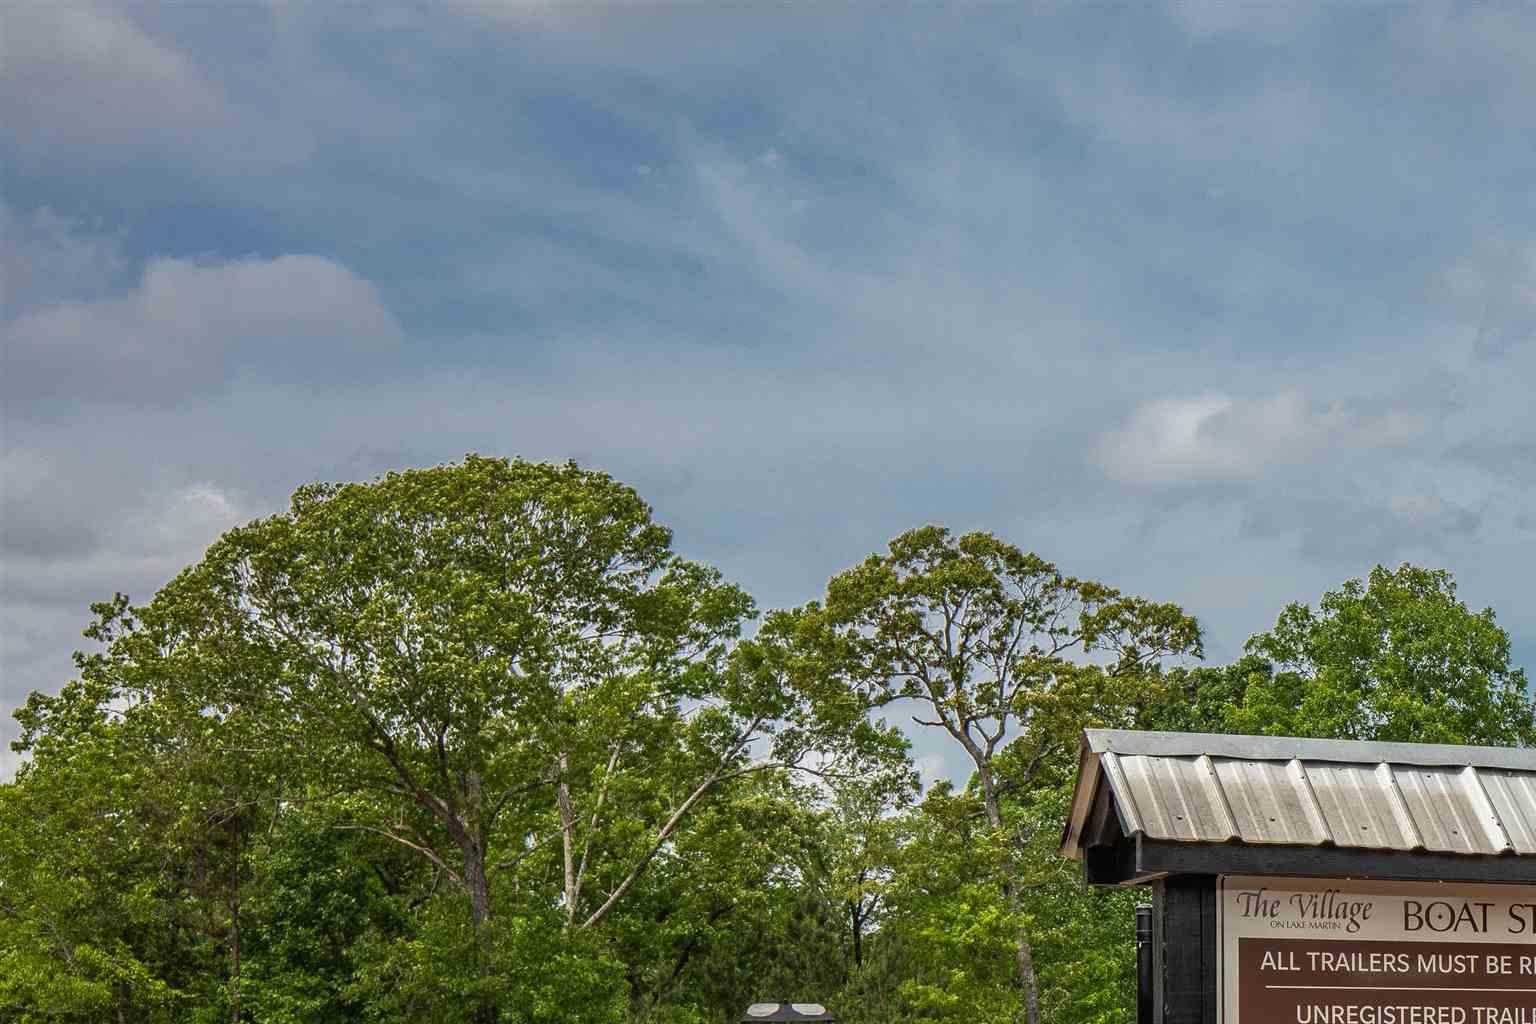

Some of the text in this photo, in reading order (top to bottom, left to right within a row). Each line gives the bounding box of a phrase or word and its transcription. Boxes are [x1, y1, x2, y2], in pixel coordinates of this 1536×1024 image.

[1237, 888, 1372, 933] The Village
[1404, 901, 1494, 933] BOAT
[1270, 920, 1341, 930] ON LAKE MARTIN
[1260, 951, 1300, 971] ALL
[1307, 952, 1410, 973] TRAILERS
[1417, 955, 1479, 974] MUST
[1486, 956, 1513, 975] BE
[1296, 1005, 1466, 1024] UNREGISTERED
